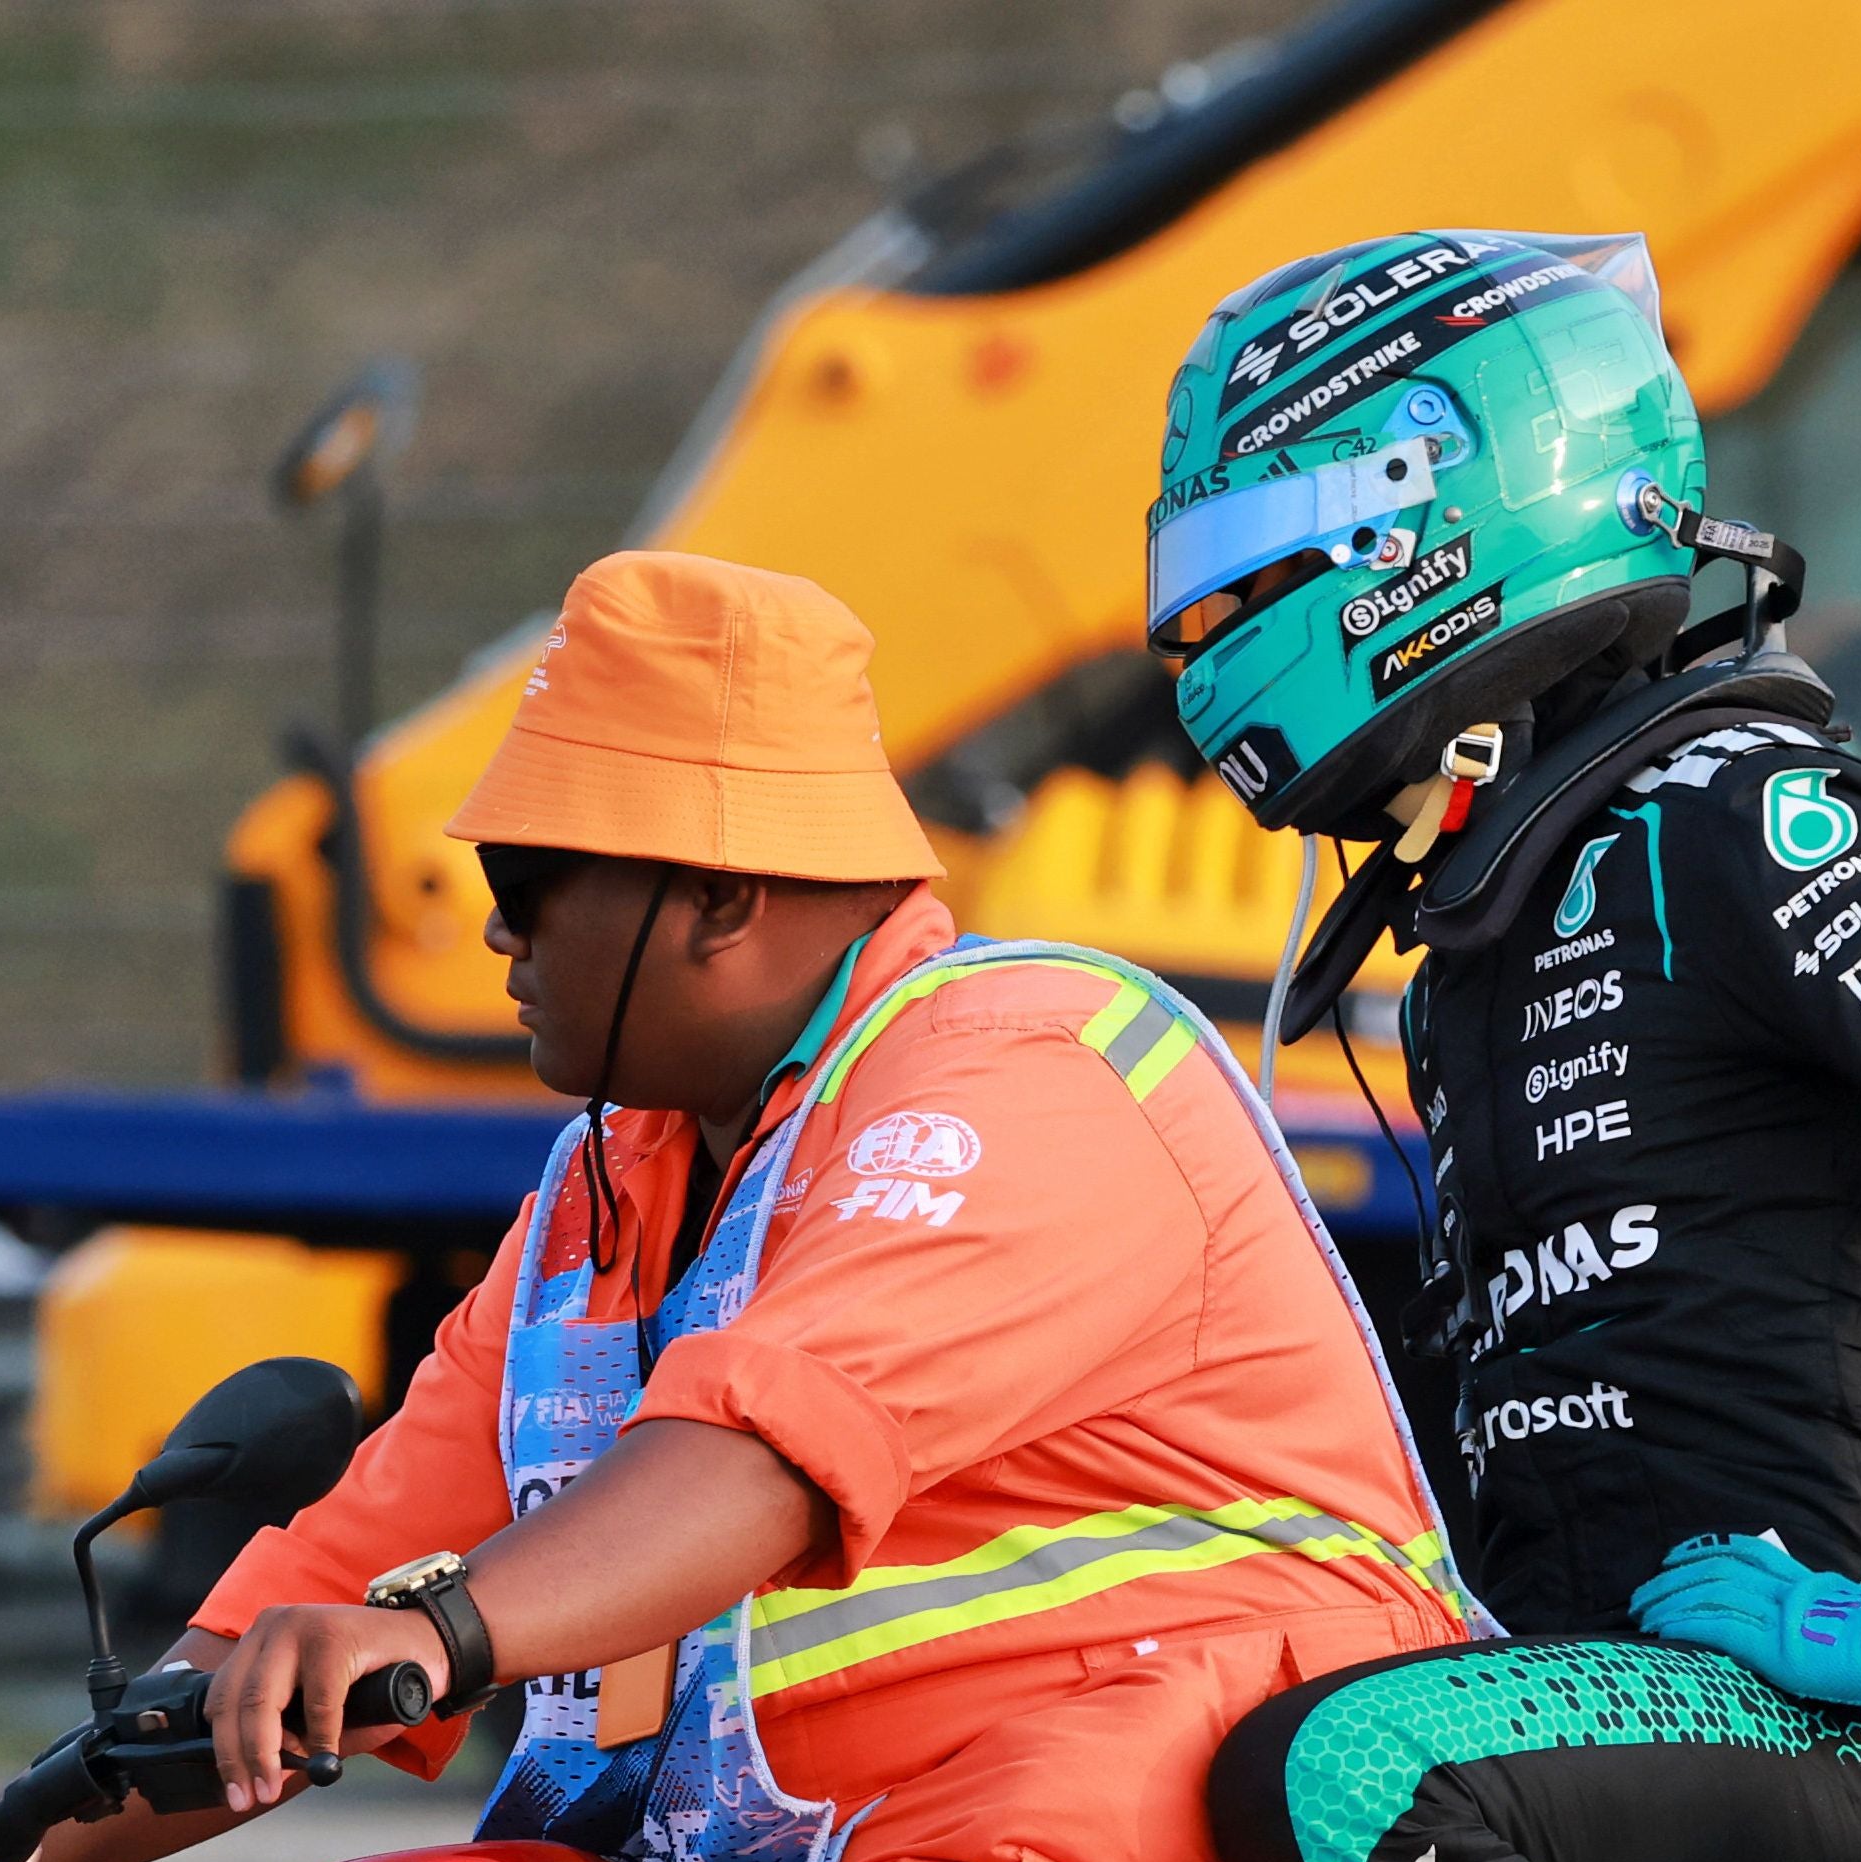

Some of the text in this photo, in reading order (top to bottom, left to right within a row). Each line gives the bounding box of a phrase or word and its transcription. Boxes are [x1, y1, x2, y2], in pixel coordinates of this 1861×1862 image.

[1288, 239, 1500, 353] SOLERA
[1237, 331, 1422, 454] CROWDSTRIKE
[1150, 464, 1230, 526] ONAS
[1534, 928, 1615, 973] PETRONAS
[1521, 969, 1624, 1042] INEOS
[1536, 1099, 1632, 1162] HPE
[776, 1178, 808, 1201] ONAS
[830, 1178, 966, 1227] FIM
[1476, 1381, 1634, 1472] rosoft
